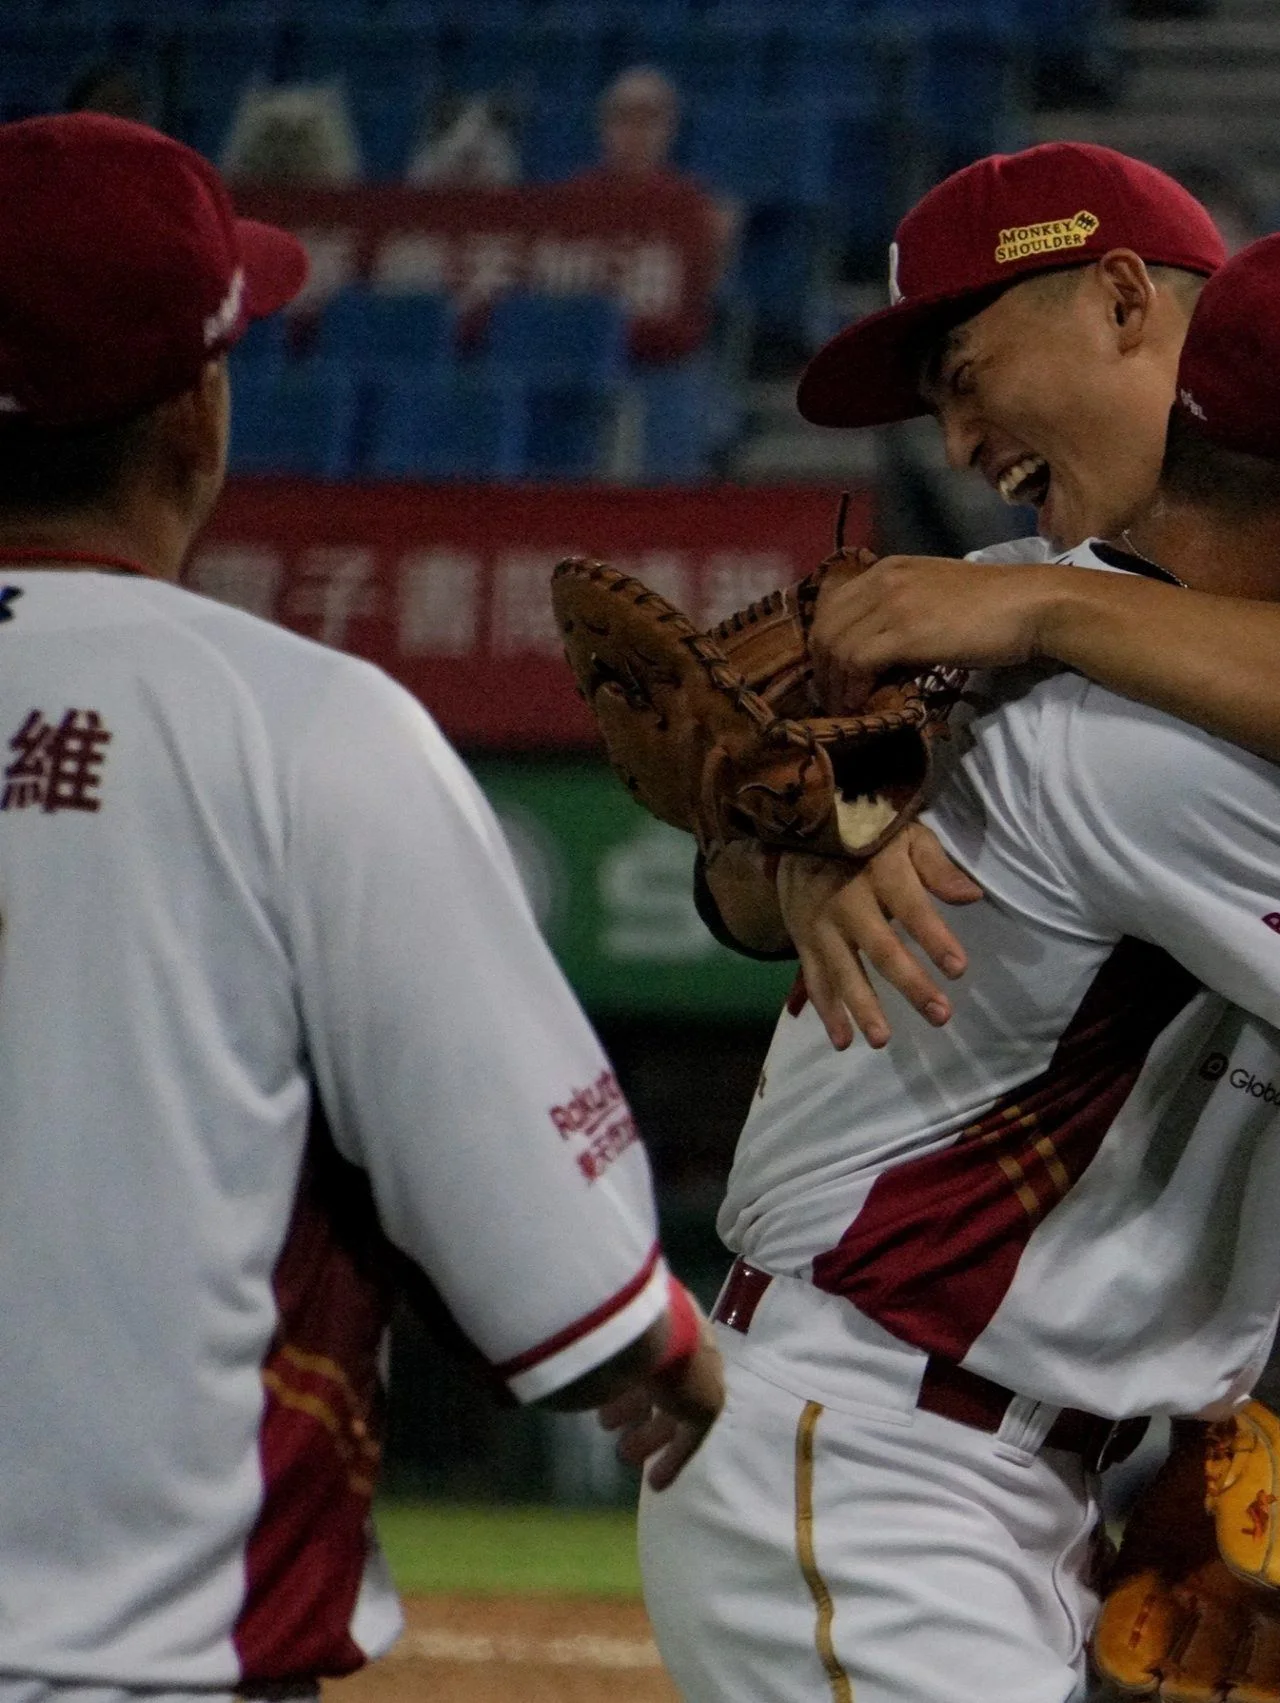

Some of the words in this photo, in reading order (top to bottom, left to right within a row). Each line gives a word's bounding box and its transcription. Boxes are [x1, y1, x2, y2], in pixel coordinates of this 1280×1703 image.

[1002, 220, 1074, 245] MONKEY
[997, 234, 1082, 260] SHOULDER
[0, 708, 112, 813] 維
